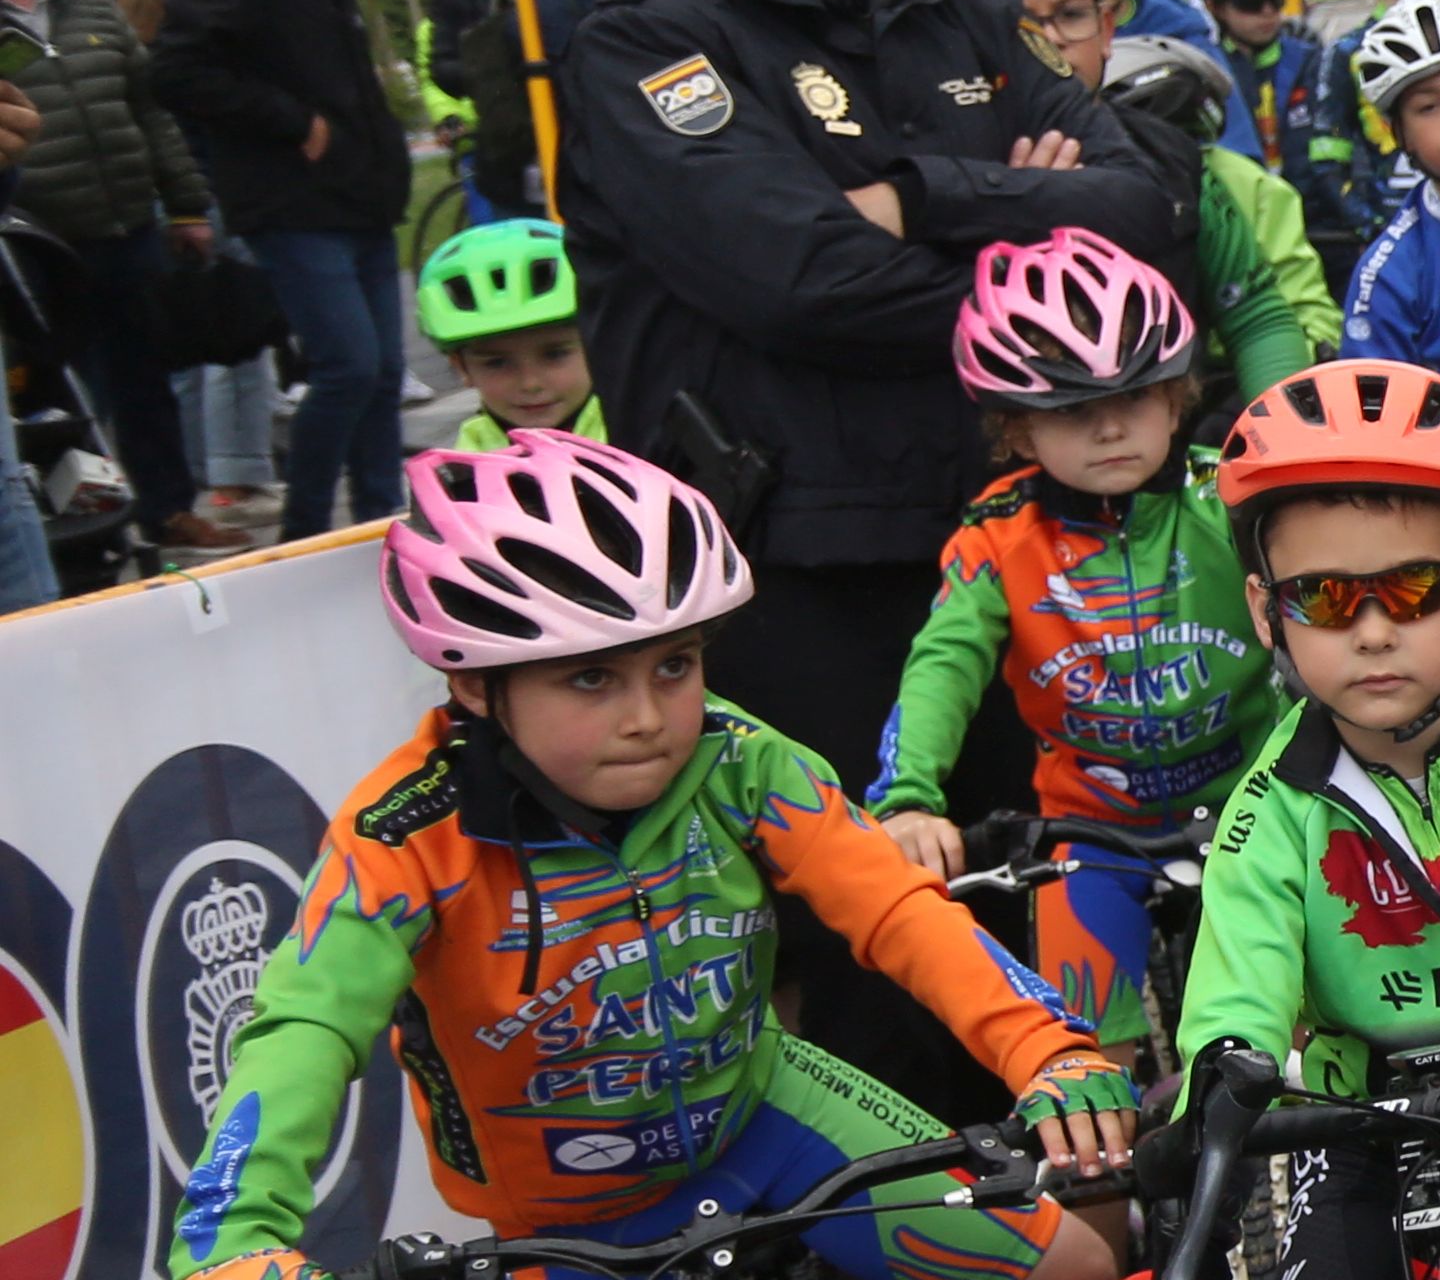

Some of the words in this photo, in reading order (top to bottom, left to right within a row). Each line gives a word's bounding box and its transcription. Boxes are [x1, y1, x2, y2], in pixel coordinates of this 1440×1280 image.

[656, 74, 719, 113] 200
[1353, 239, 1396, 316] Tartiere
[1029, 630, 1137, 688] Escuela
[1150, 621, 1247, 659] Ciclista
[1061, 648, 1211, 709] SANTI
[1061, 688, 1232, 754] PEREZ
[1218, 807, 1257, 857] las
[474, 937, 650, 1053] Escuela
[531, 942, 758, 1056] SANTI
[524, 992, 764, 1107] PEREZ
